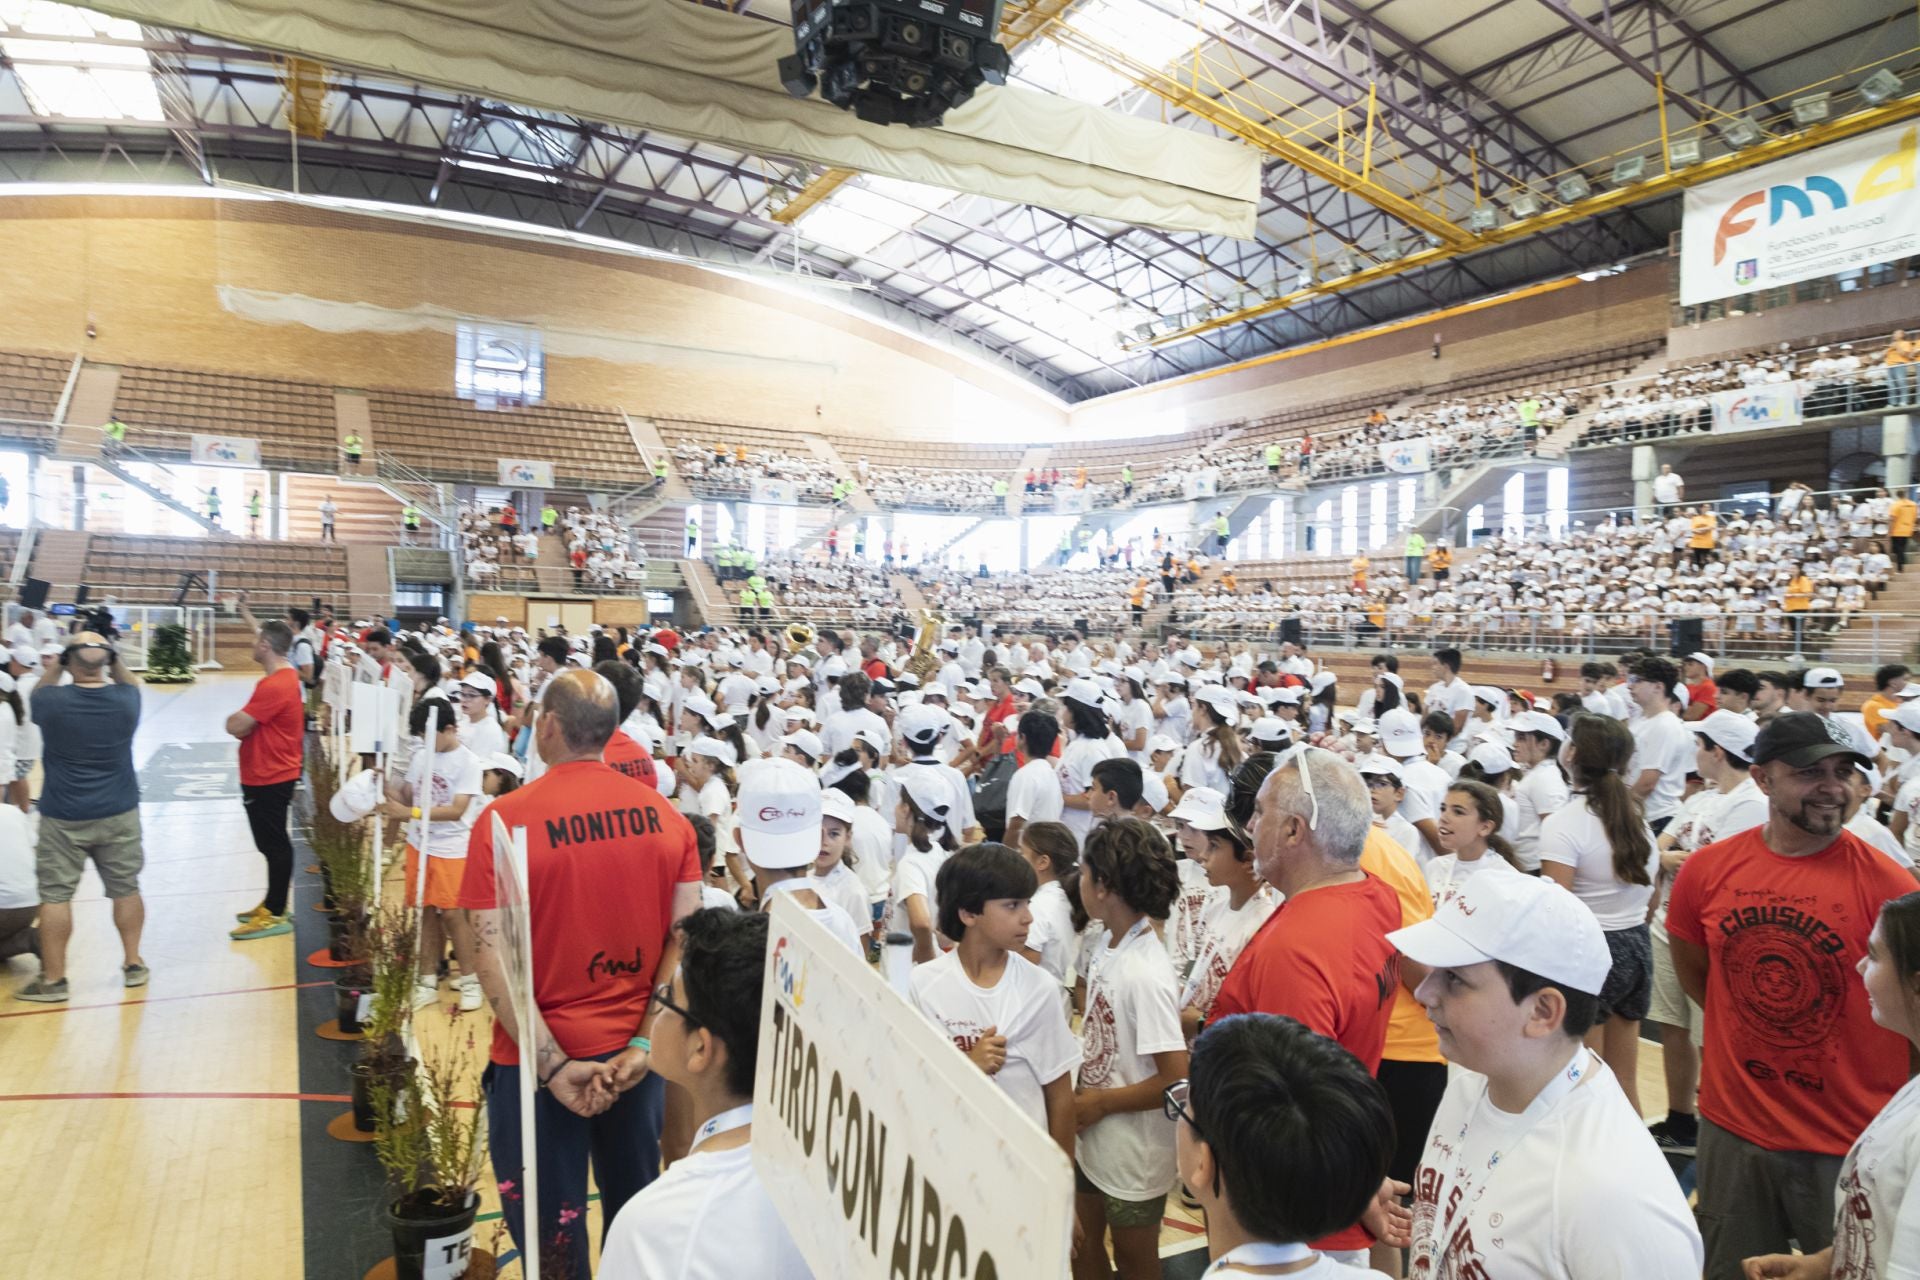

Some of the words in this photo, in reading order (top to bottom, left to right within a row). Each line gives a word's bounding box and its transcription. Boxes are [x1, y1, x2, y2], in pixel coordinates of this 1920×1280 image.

[544, 806, 663, 849] MONITOR
[1719, 905, 1845, 954] clausura
[770, 999, 820, 1158] TIRO
[825, 1069, 888, 1258] CON
[890, 1153, 999, 1280] ARC
